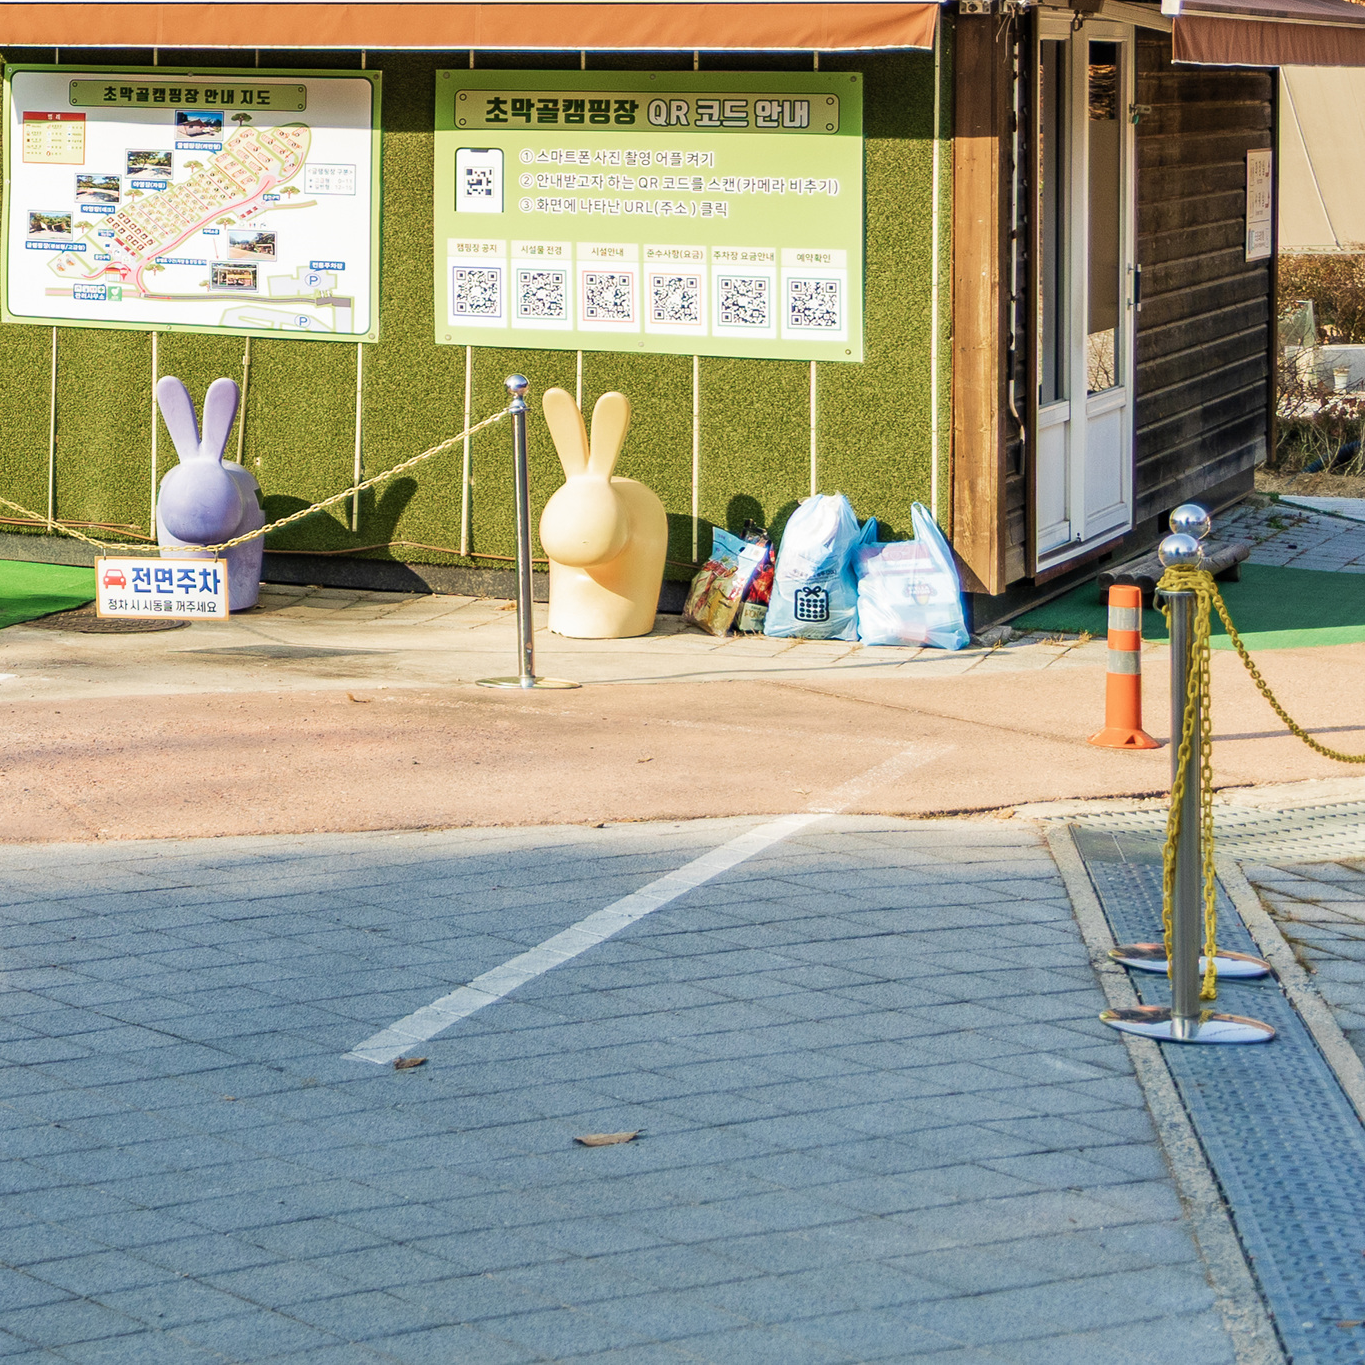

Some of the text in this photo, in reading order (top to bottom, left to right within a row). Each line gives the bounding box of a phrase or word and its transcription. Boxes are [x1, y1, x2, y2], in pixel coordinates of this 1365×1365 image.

[103, 86, 271, 105] 초막골캠핑장 안내 지도
[485, 96, 811, 129] 초막골캠핑장 QR 코드 안내
[536, 149, 591, 165] 스마트폰
[594, 150, 621, 166] 사진
[624, 150, 652, 166] 촬영
[655, 151, 683, 166] 어플
[685, 151, 714, 167] 켜기
[536, 173, 604, 190] 안내받고자
[607, 175, 634, 190] 하는
[638, 177, 659, 190] QR
[662, 177, 704, 192] 코드를
[789, 179, 839, 195] 비추기)
[536, 198, 576, 214] 화면에
[579, 199, 621, 214] 나타난
[700, 202, 728, 217] 클릭
[456, 243, 480, 253] 캠핑장
[481, 244, 497, 253] 공지
[520, 245, 545, 255] 시설물
[546, 245, 562, 255] 전경
[591, 247, 624, 257] 시설안내
[712, 250, 739, 261] 주차장
[740, 251, 775, 262] 요금안내
[796, 252, 831, 264] 예약확인
[131, 567, 221, 595] 전면주차
[108, 598, 217, 613] 정차 시 시동을 꺼주세요
